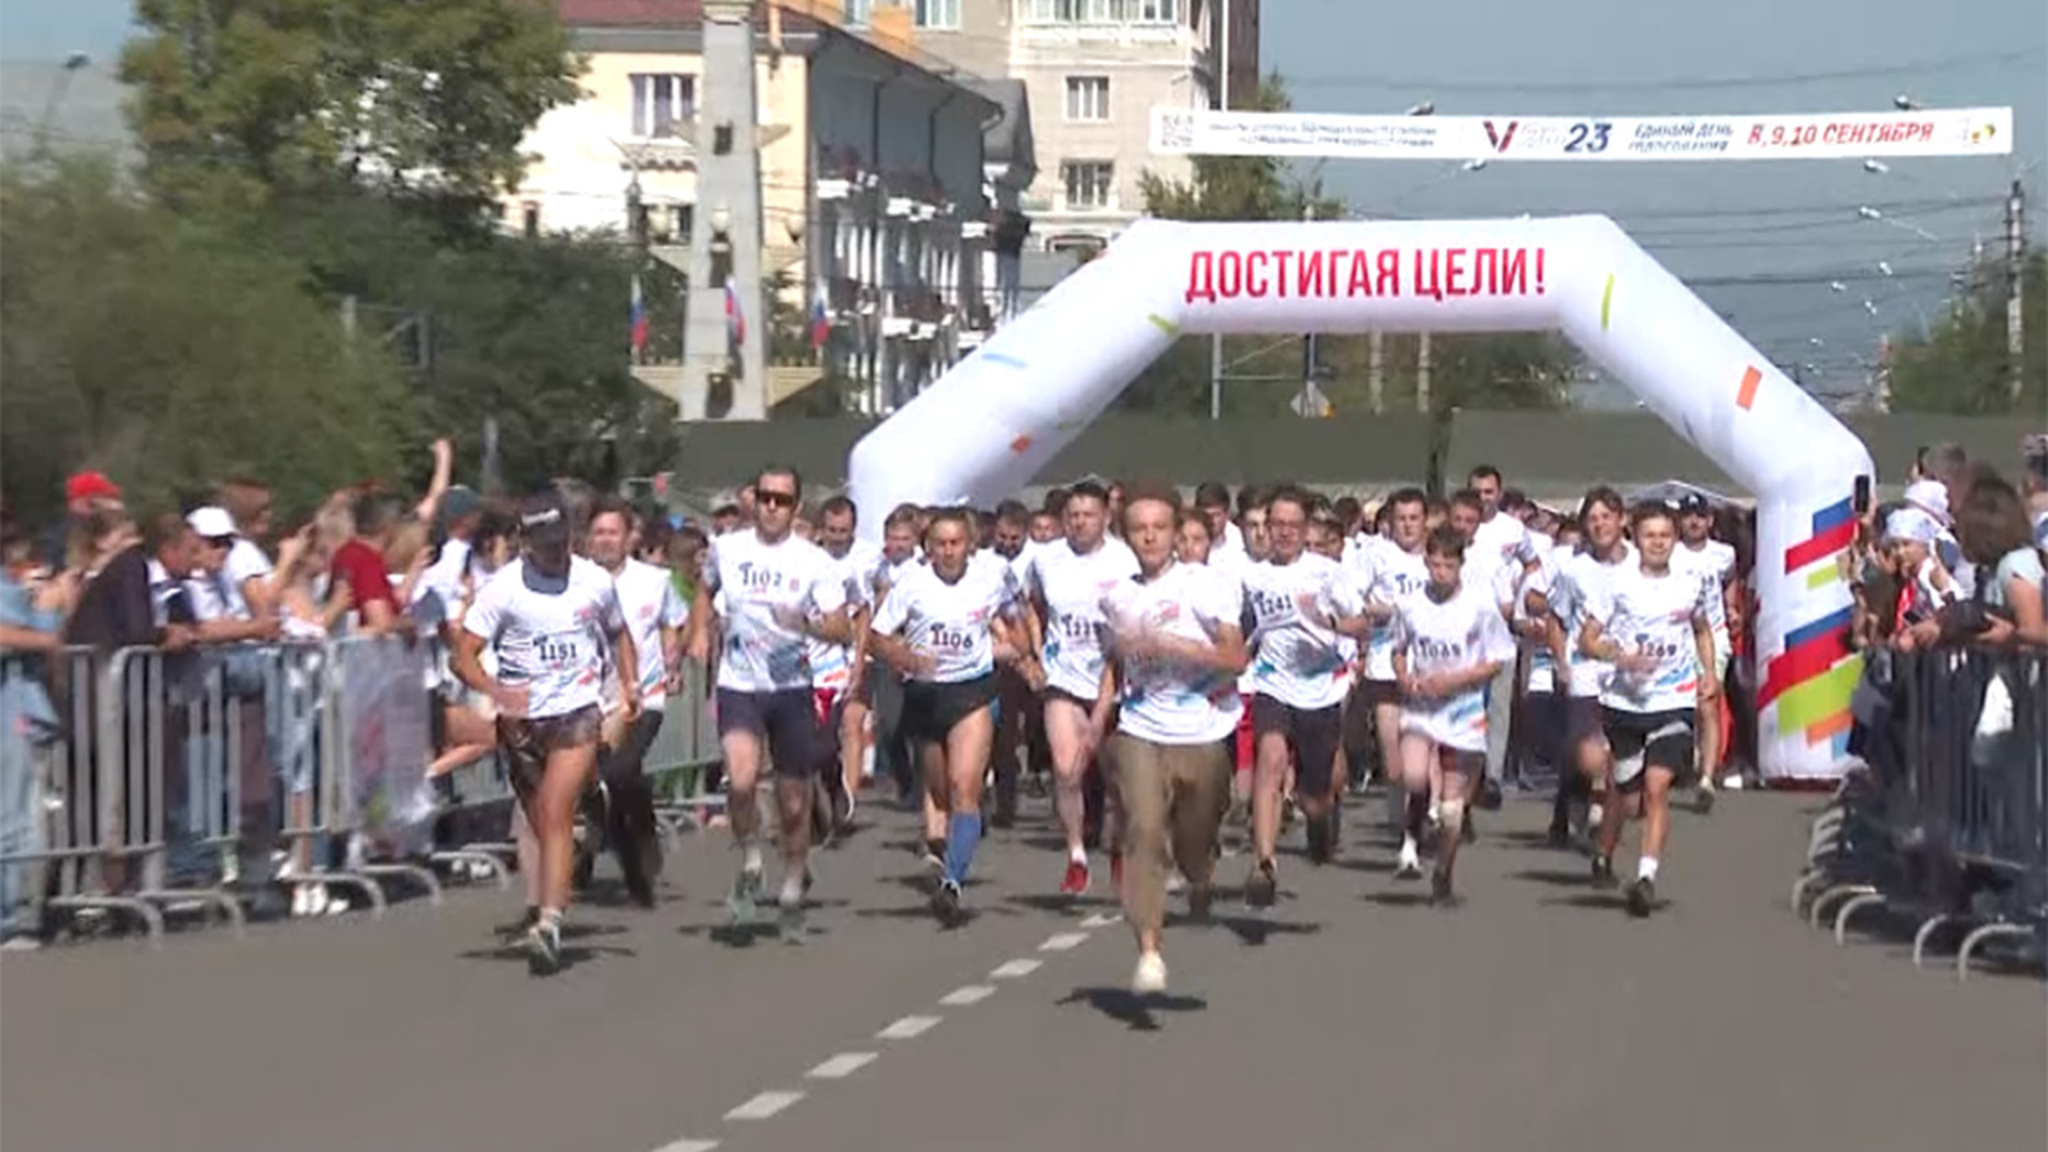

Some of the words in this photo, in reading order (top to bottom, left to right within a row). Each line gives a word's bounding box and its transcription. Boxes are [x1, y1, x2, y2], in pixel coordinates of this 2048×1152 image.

[1822, 121, 1935, 146] СЕНТЯБРЯ
[1185, 250, 1400, 303] ДОСТИГАЯ
[1414, 248, 1546, 301] ЦЕЛИ!
